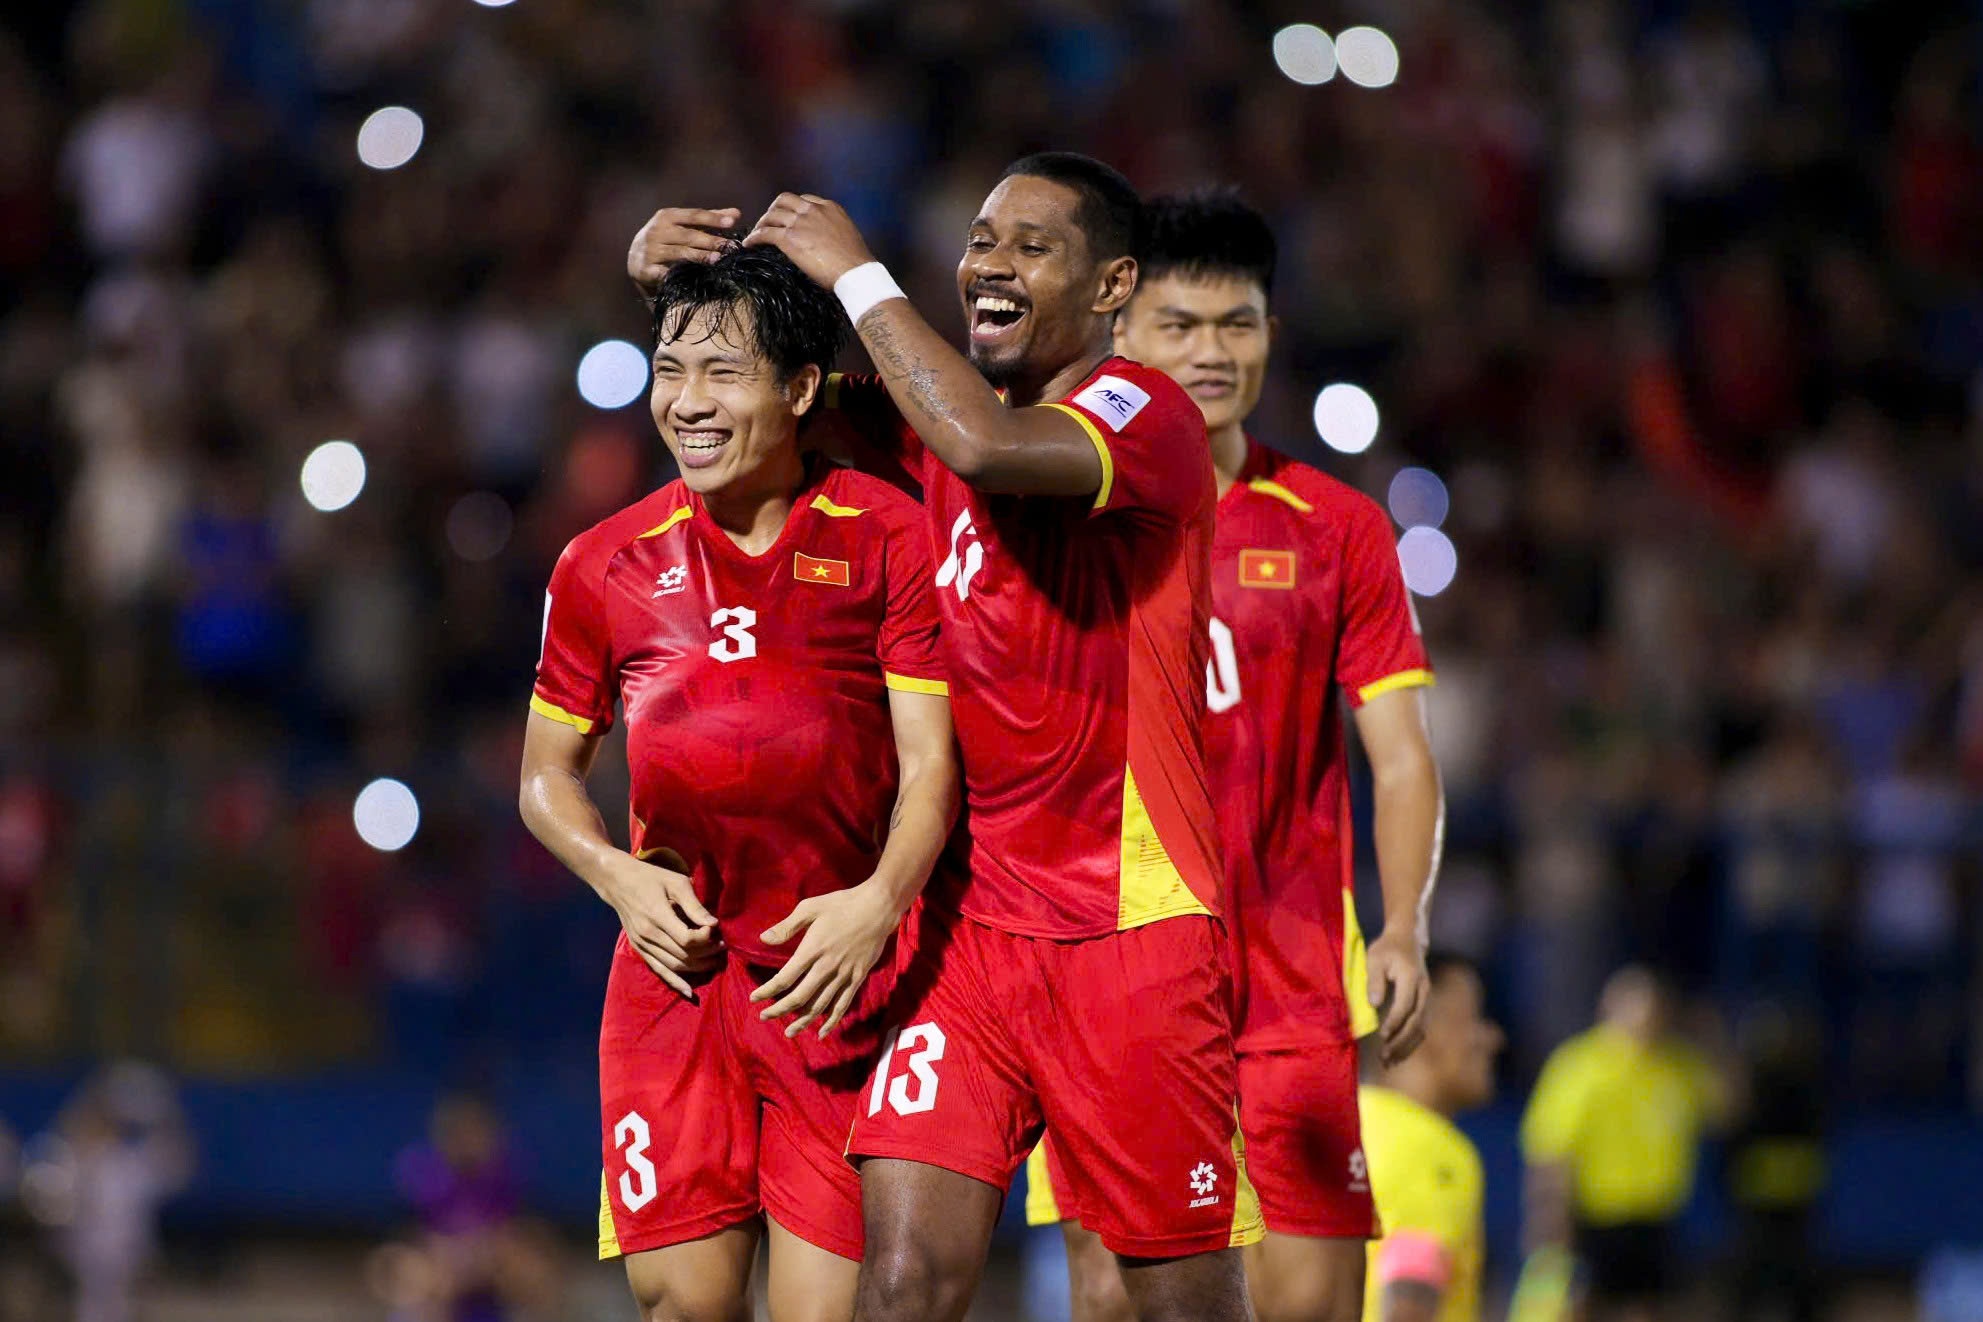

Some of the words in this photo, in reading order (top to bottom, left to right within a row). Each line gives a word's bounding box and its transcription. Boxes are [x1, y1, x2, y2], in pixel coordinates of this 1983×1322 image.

[1094, 389, 1135, 413] AFC
[708, 605, 757, 663] 3
[867, 1021, 947, 1119] 13
[614, 1110, 657, 1214] 3
